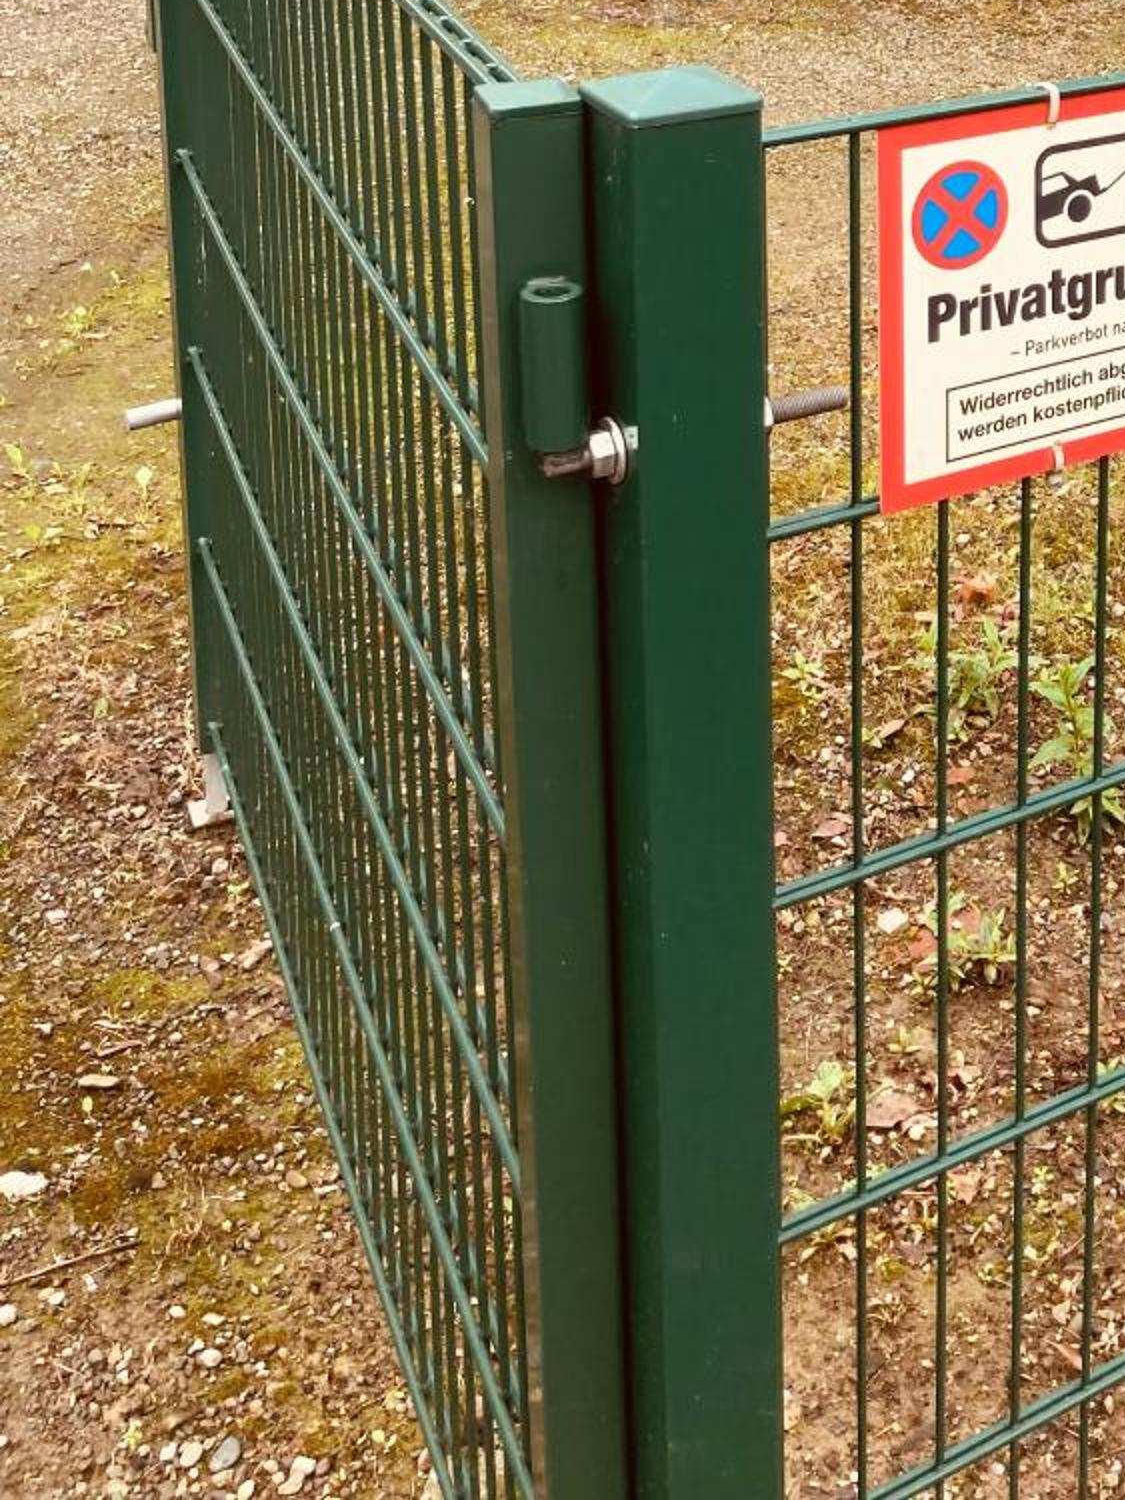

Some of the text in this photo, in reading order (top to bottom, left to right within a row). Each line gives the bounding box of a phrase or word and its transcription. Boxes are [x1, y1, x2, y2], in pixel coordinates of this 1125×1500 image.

[1025, 324, 1107, 356] Parkverbot
[959, 369, 1093, 415] Widerrechtlich
[958, 412, 1027, 442] werden
